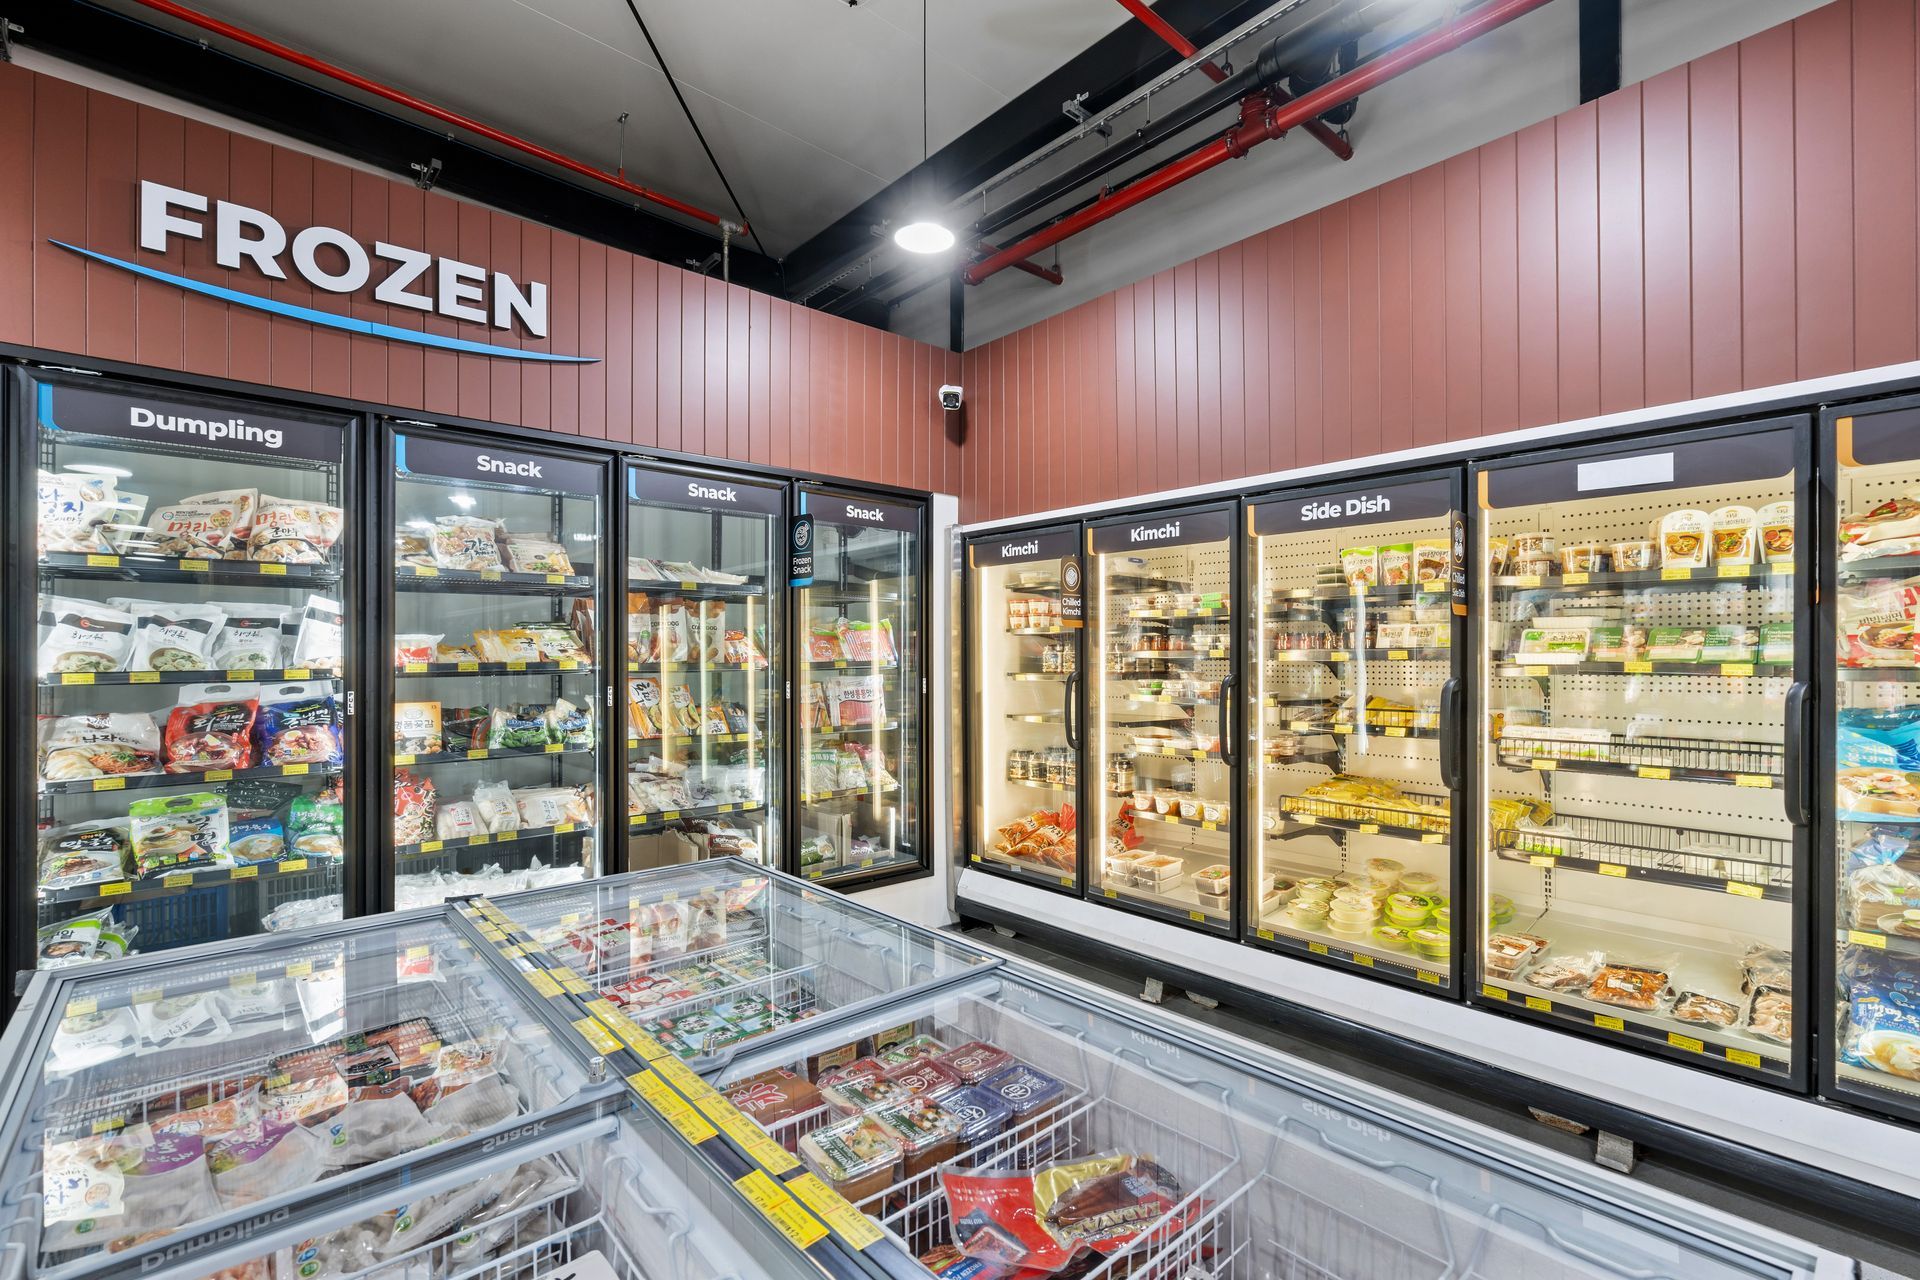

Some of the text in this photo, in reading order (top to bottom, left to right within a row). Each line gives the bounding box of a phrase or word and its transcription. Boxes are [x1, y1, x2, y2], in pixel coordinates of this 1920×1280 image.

[140, 179, 547, 338] FROZEN
[129, 406, 284, 449] Dumpling
[476, 455, 542, 478] Snack
[687, 482, 737, 502] Snack
[846, 505, 884, 521] Snack
[1300, 495, 1391, 521] Side Dish
[1130, 521, 1180, 542] Kimchi
[1001, 540, 1038, 558] Kimchi
[792, 556, 812, 565] Frozen
[792, 565, 812, 575] Snack
[1062, 597, 1081, 607] Chilled
[1062, 607, 1081, 616] Kimchi
